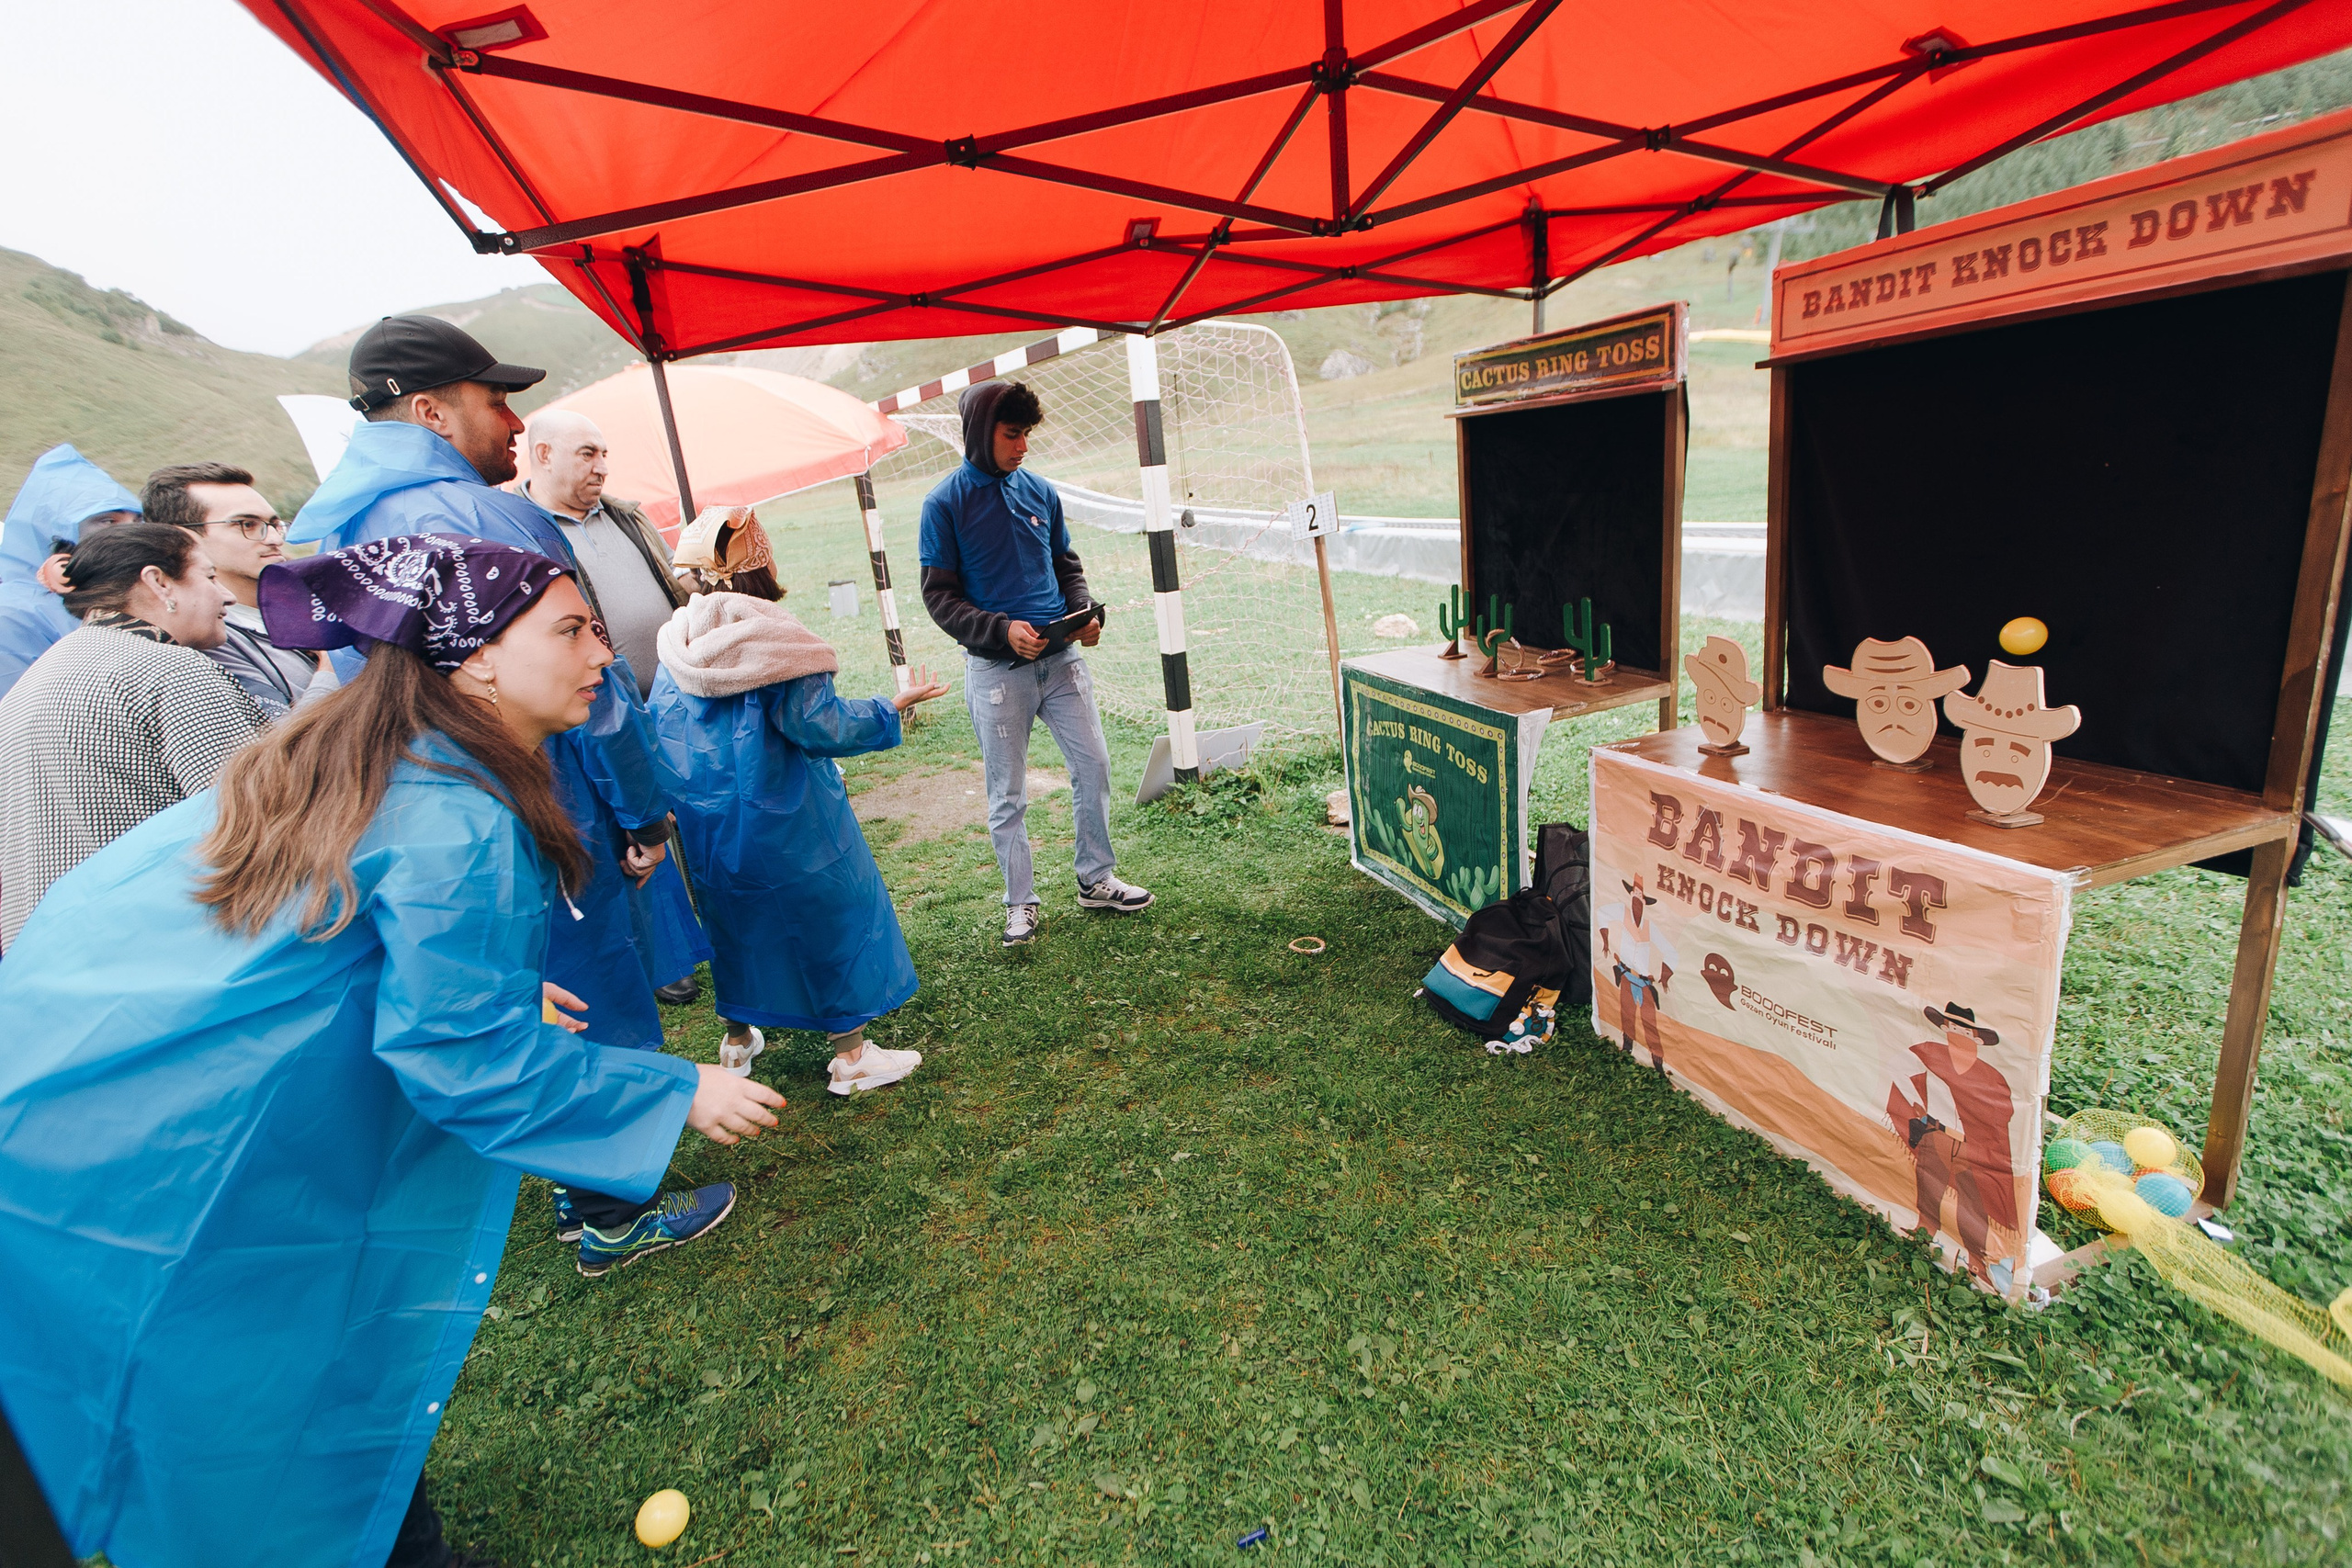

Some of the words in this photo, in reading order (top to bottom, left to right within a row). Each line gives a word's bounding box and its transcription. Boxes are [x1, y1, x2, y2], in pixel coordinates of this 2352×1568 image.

[1802, 262, 1937, 320] BANDIT
[1951, 220, 2109, 286] KNOCK
[2128, 169, 2317, 250] DOWN
[1461, 362, 1530, 390] CACTUS
[1535, 350, 1589, 379] RING
[1596, 335, 1660, 367] TOSS
[1306, 503, 1319, 532] 2
[1366, 720, 1406, 739] CACTUS
[1408, 725, 1442, 754] RING
[1445, 742, 1488, 784] TOSS
[1646, 790, 1948, 944] BANDIT
[1656, 863, 1760, 934] KNOCK
[1775, 914, 1914, 989] DOWN
[1741, 984, 1838, 1038] BOOOFEST
[1765, 1012, 1790, 1031] Oyun
